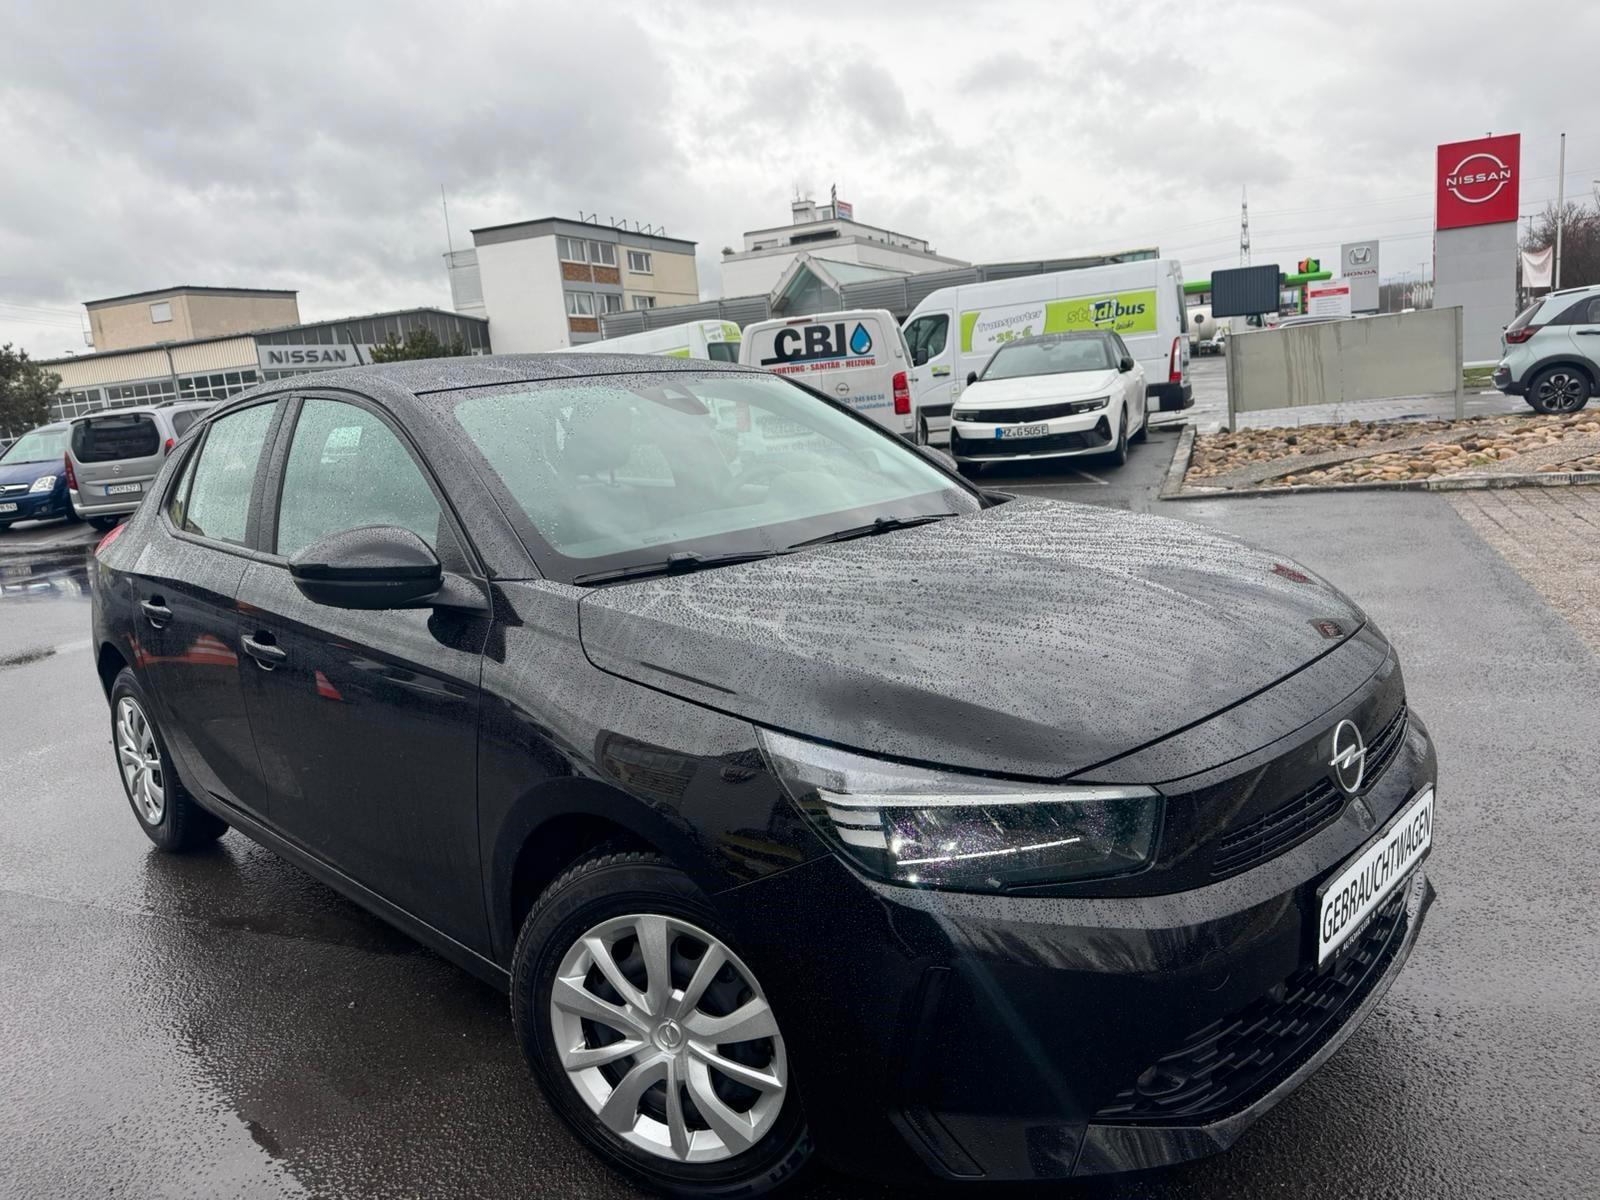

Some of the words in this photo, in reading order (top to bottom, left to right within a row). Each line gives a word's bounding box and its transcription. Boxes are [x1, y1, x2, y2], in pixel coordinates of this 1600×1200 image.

[1446, 170, 1511, 187] NISSAN
[1343, 270, 1377, 278] HONDA
[977, 310, 1042, 332] Transporter
[770, 323, 847, 360] CBI
[268, 350, 347, 364] NISSAN
[846, 359, 876, 368] HEIZUNG
[1323, 801, 1432, 943] GEBRAUCHTWAGEN
